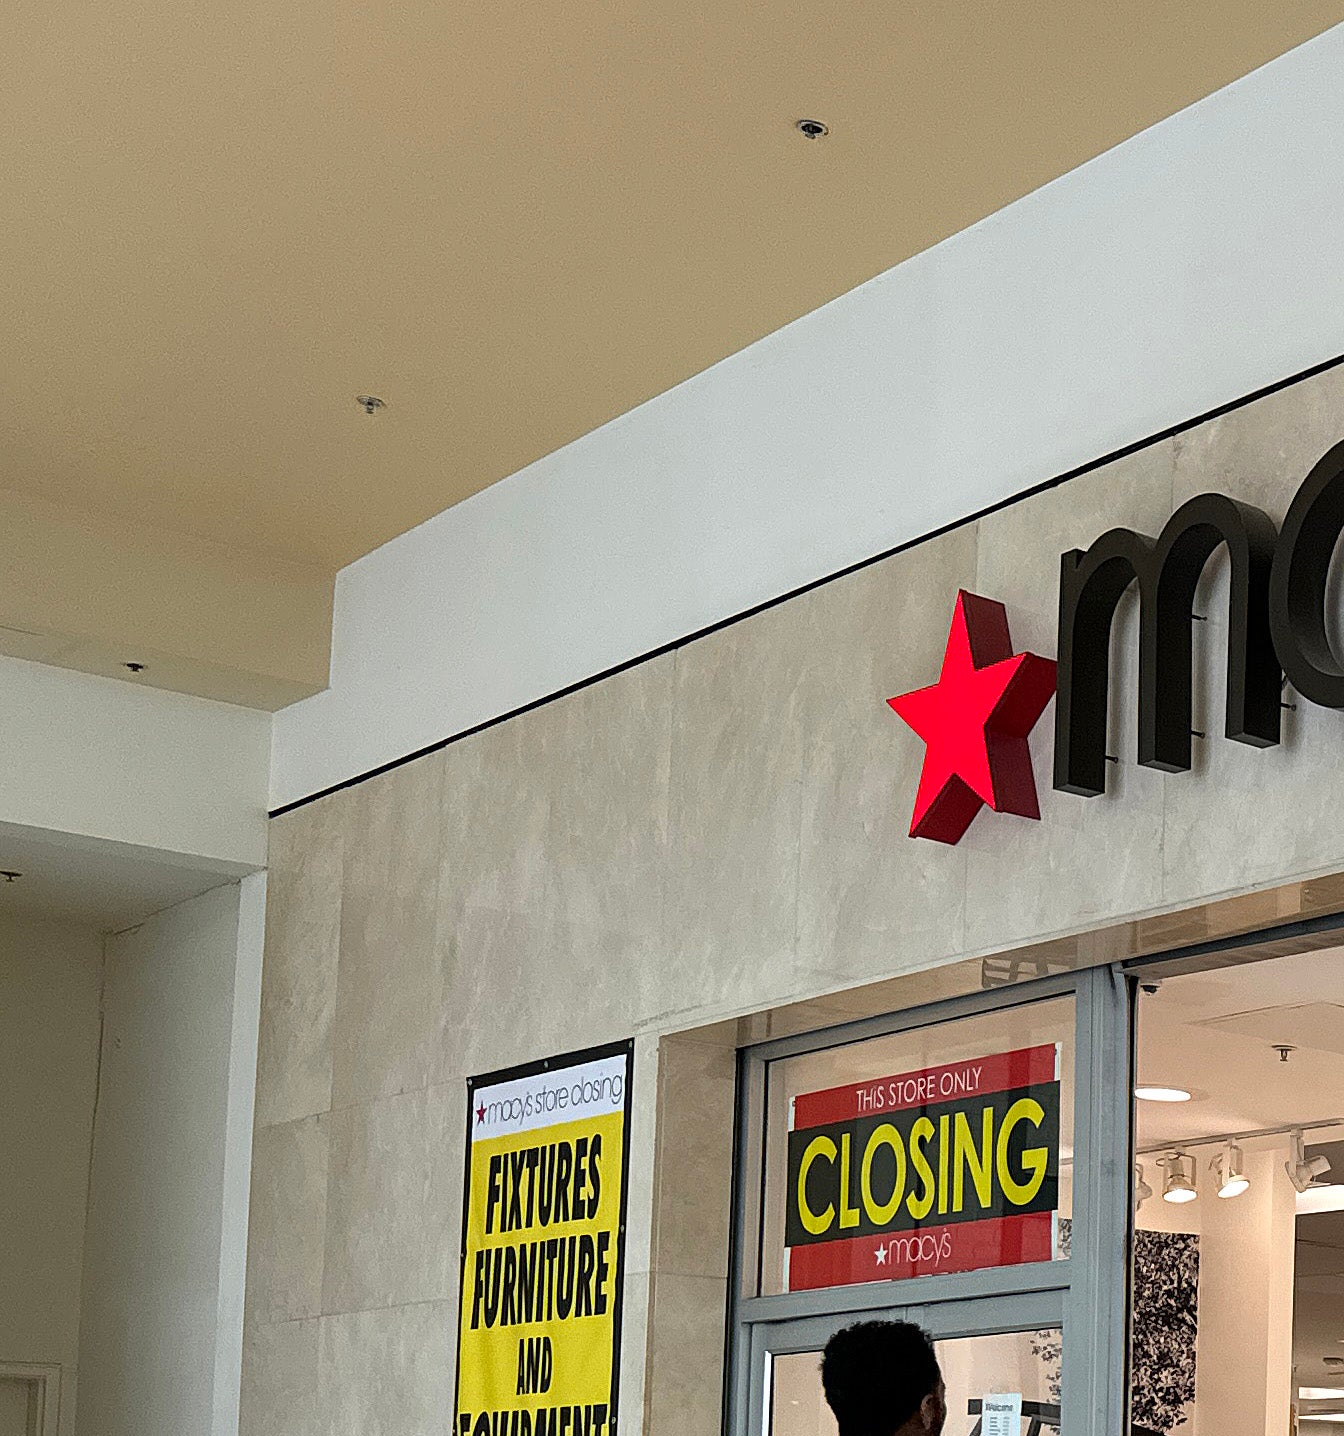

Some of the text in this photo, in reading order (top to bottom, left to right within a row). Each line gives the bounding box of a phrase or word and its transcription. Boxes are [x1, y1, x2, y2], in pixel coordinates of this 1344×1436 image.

[535, 1085, 569, 1114] store
[571, 1072, 623, 1105] closing
[856, 1066, 983, 1112] THIS STORE ONLY
[485, 1133, 603, 1235] FIXTURES
[797, 1098, 1049, 1235] CLOSING
[888, 1228, 952, 1267] macy's
[470, 1230, 611, 1330] FURNITURE
[516, 1336, 552, 1396] AND
